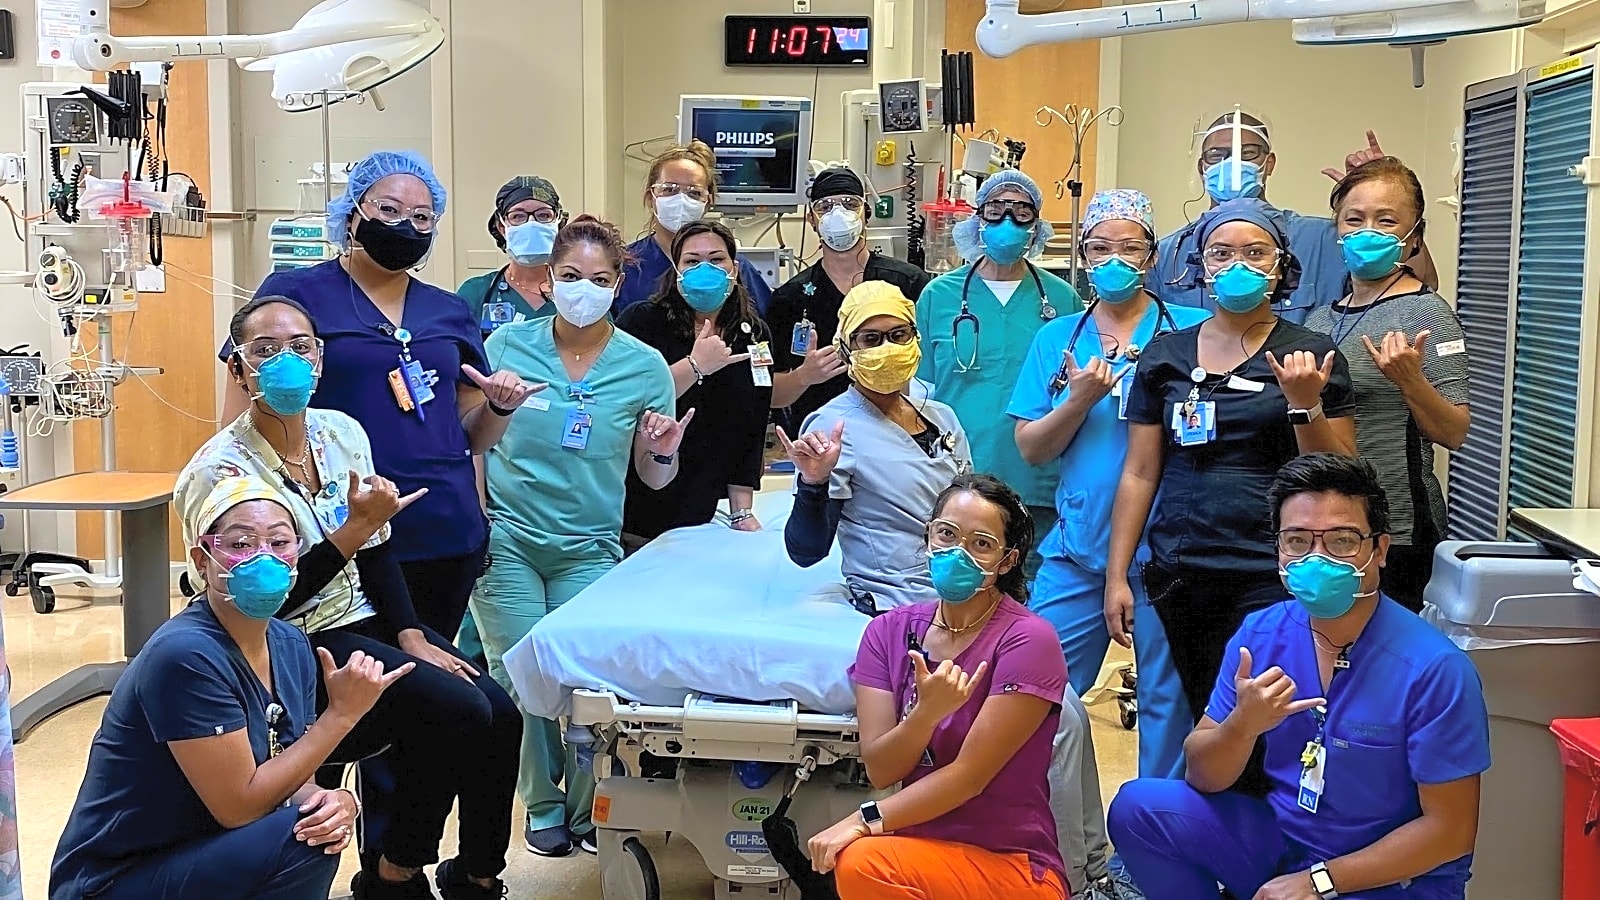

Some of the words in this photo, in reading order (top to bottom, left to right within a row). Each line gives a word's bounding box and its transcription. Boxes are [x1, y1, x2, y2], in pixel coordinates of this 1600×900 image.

[748, 27, 832, 55] 11:07
[836, 27, 860, 44] 24
[715, 131, 775, 145] PHILIPS
[740, 805, 758, 814] JAN
[759, 806, 770, 815] 21
[730, 834, 768, 845] Hill-Ro
